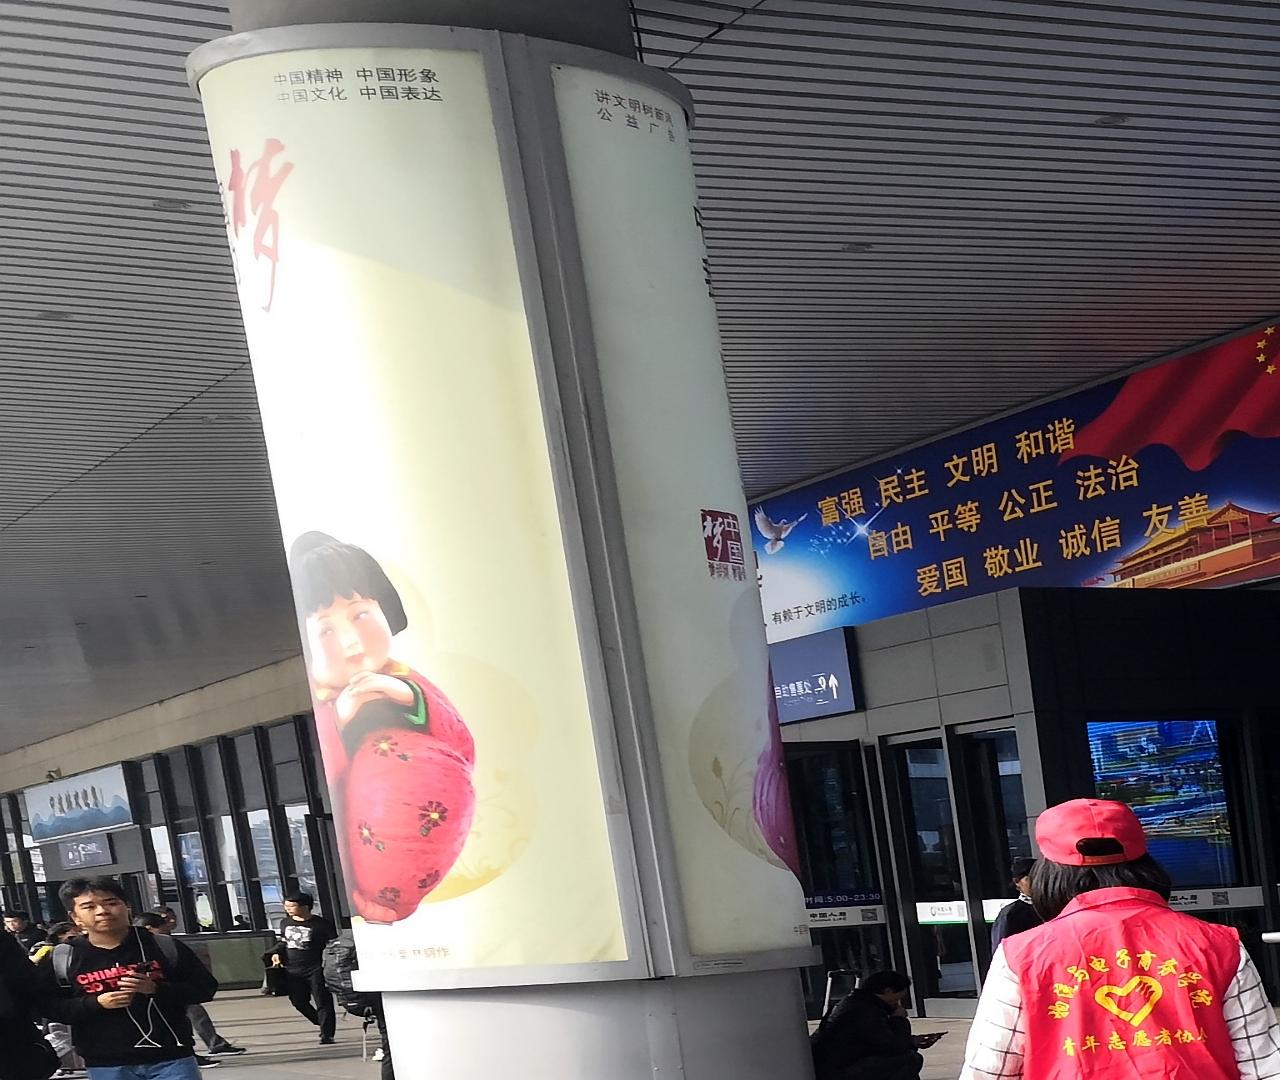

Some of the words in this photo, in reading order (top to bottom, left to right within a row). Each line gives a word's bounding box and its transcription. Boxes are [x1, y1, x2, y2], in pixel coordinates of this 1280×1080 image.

[274, 68, 343, 86] 中国精神
[356, 67, 439, 83] 中国形象
[278, 86, 347, 104] 中国文化
[360, 86, 443, 102] 中国表达
[593, 89, 674, 128] 讲文明树新风
[597, 107, 676, 143] 公益广告
[817, 487, 866, 527] 富强
[879, 467, 930, 508] 民主
[945, 443, 998, 488] 文明
[1016, 417, 1077, 465] 和谐
[867, 523, 914, 561] 自由
[929, 501, 982, 542] 平等
[998, 480, 1058, 523] 公正
[1076, 454, 1141, 501] 法治
[916, 556, 969, 598] 爱国
[983, 537, 1043, 579] 敬业
[1058, 516, 1122, 560] 诚信
[1143, 491, 1212, 539] 友善
